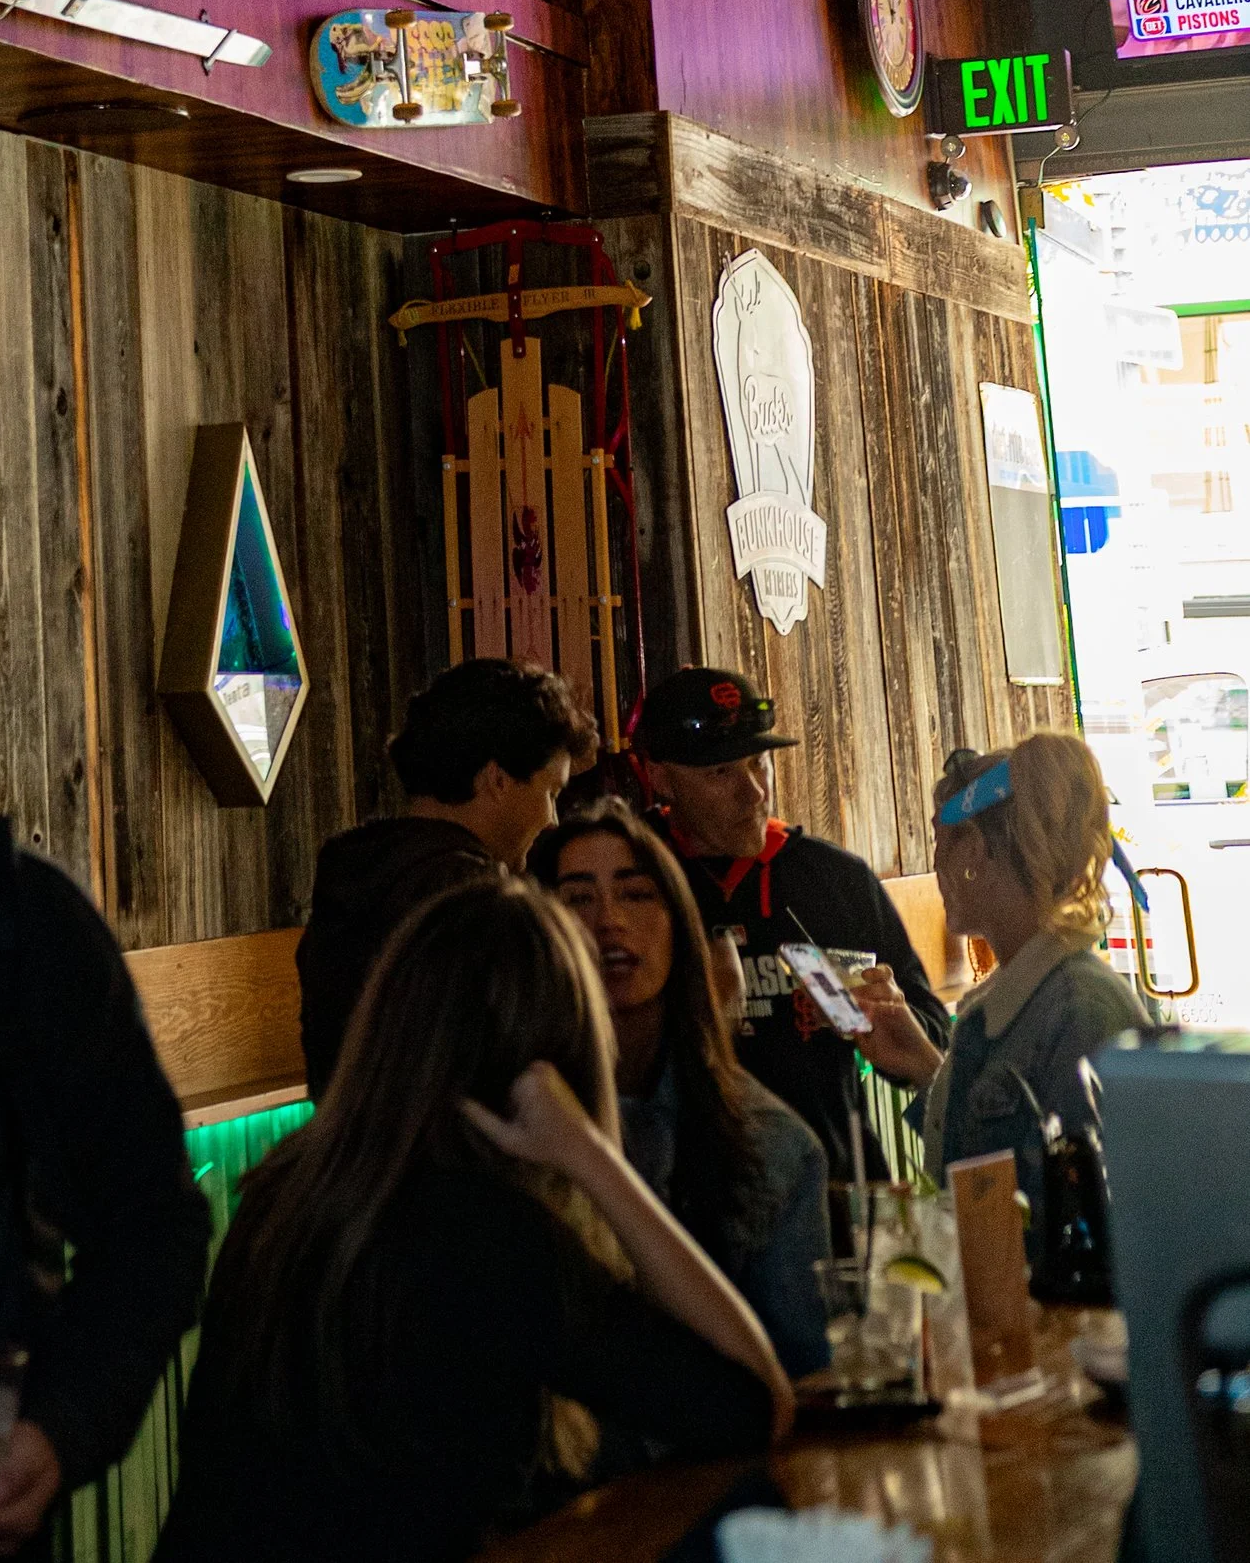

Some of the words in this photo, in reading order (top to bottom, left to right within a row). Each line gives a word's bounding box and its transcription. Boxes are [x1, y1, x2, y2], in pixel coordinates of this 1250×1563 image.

[1177, 9, 1240, 31] PISTONS
[961, 54, 1050, 128] EXIT
[735, 505, 819, 568] BUNKHOUSE
